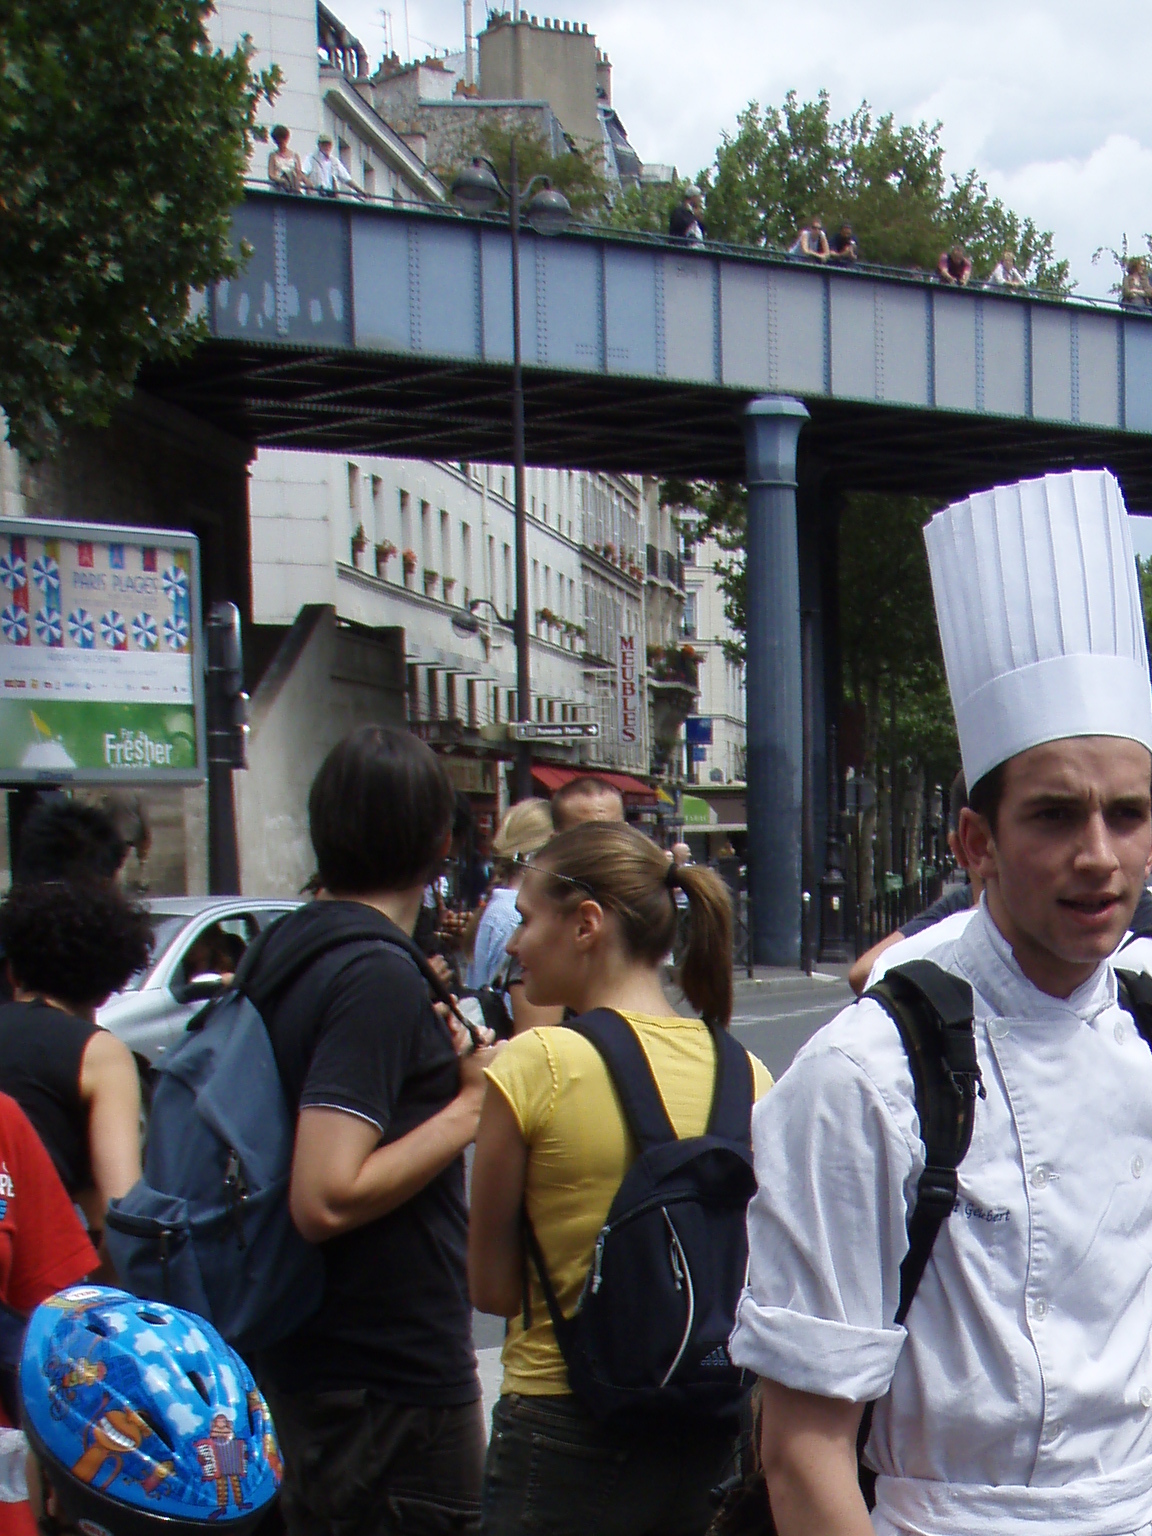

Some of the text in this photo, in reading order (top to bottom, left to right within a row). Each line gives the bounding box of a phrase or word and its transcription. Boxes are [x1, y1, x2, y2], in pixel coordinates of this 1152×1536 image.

[73, 571, 159, 595] PARIS PLAGES
[620, 635, 637, 742] MEUBLES
[104, 733, 173, 765] Fresher
